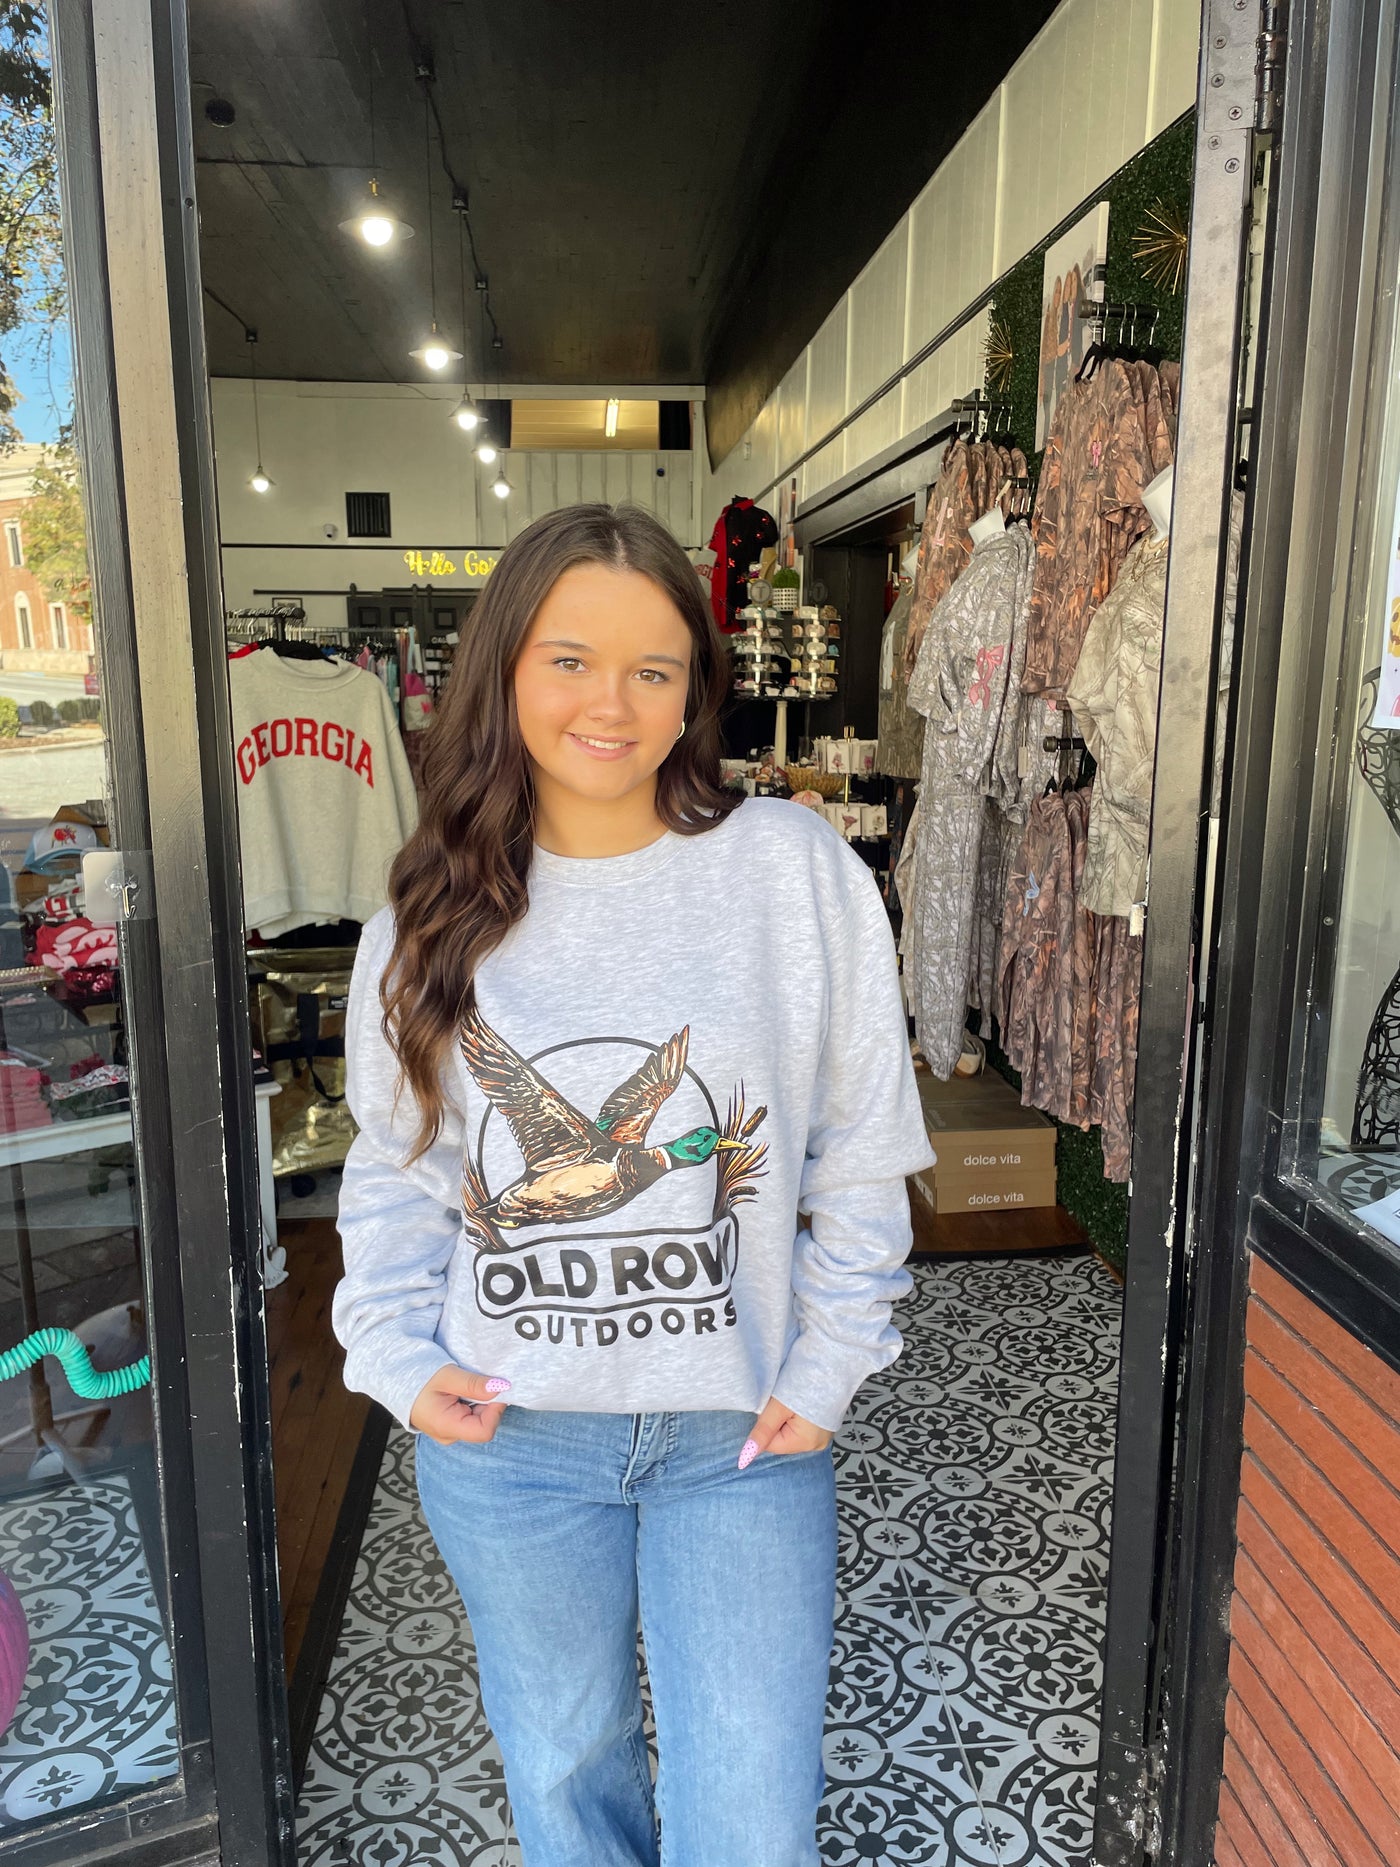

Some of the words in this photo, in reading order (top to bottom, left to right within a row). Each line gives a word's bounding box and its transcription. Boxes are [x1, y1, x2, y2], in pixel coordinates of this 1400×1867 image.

[404, 550, 456, 576] Hello
[236, 717, 375, 789] GEORGIA
[963, 1154, 996, 1166] dolce
[999, 1153, 1021, 1164] vita
[968, 1194, 1000, 1205] dolce
[1003, 1192, 1024, 1203] vita
[482, 1250, 597, 1306] OLD
[611, 1223, 731, 1296] ROW
[514, 1298, 737, 1347] OUTDOORS
